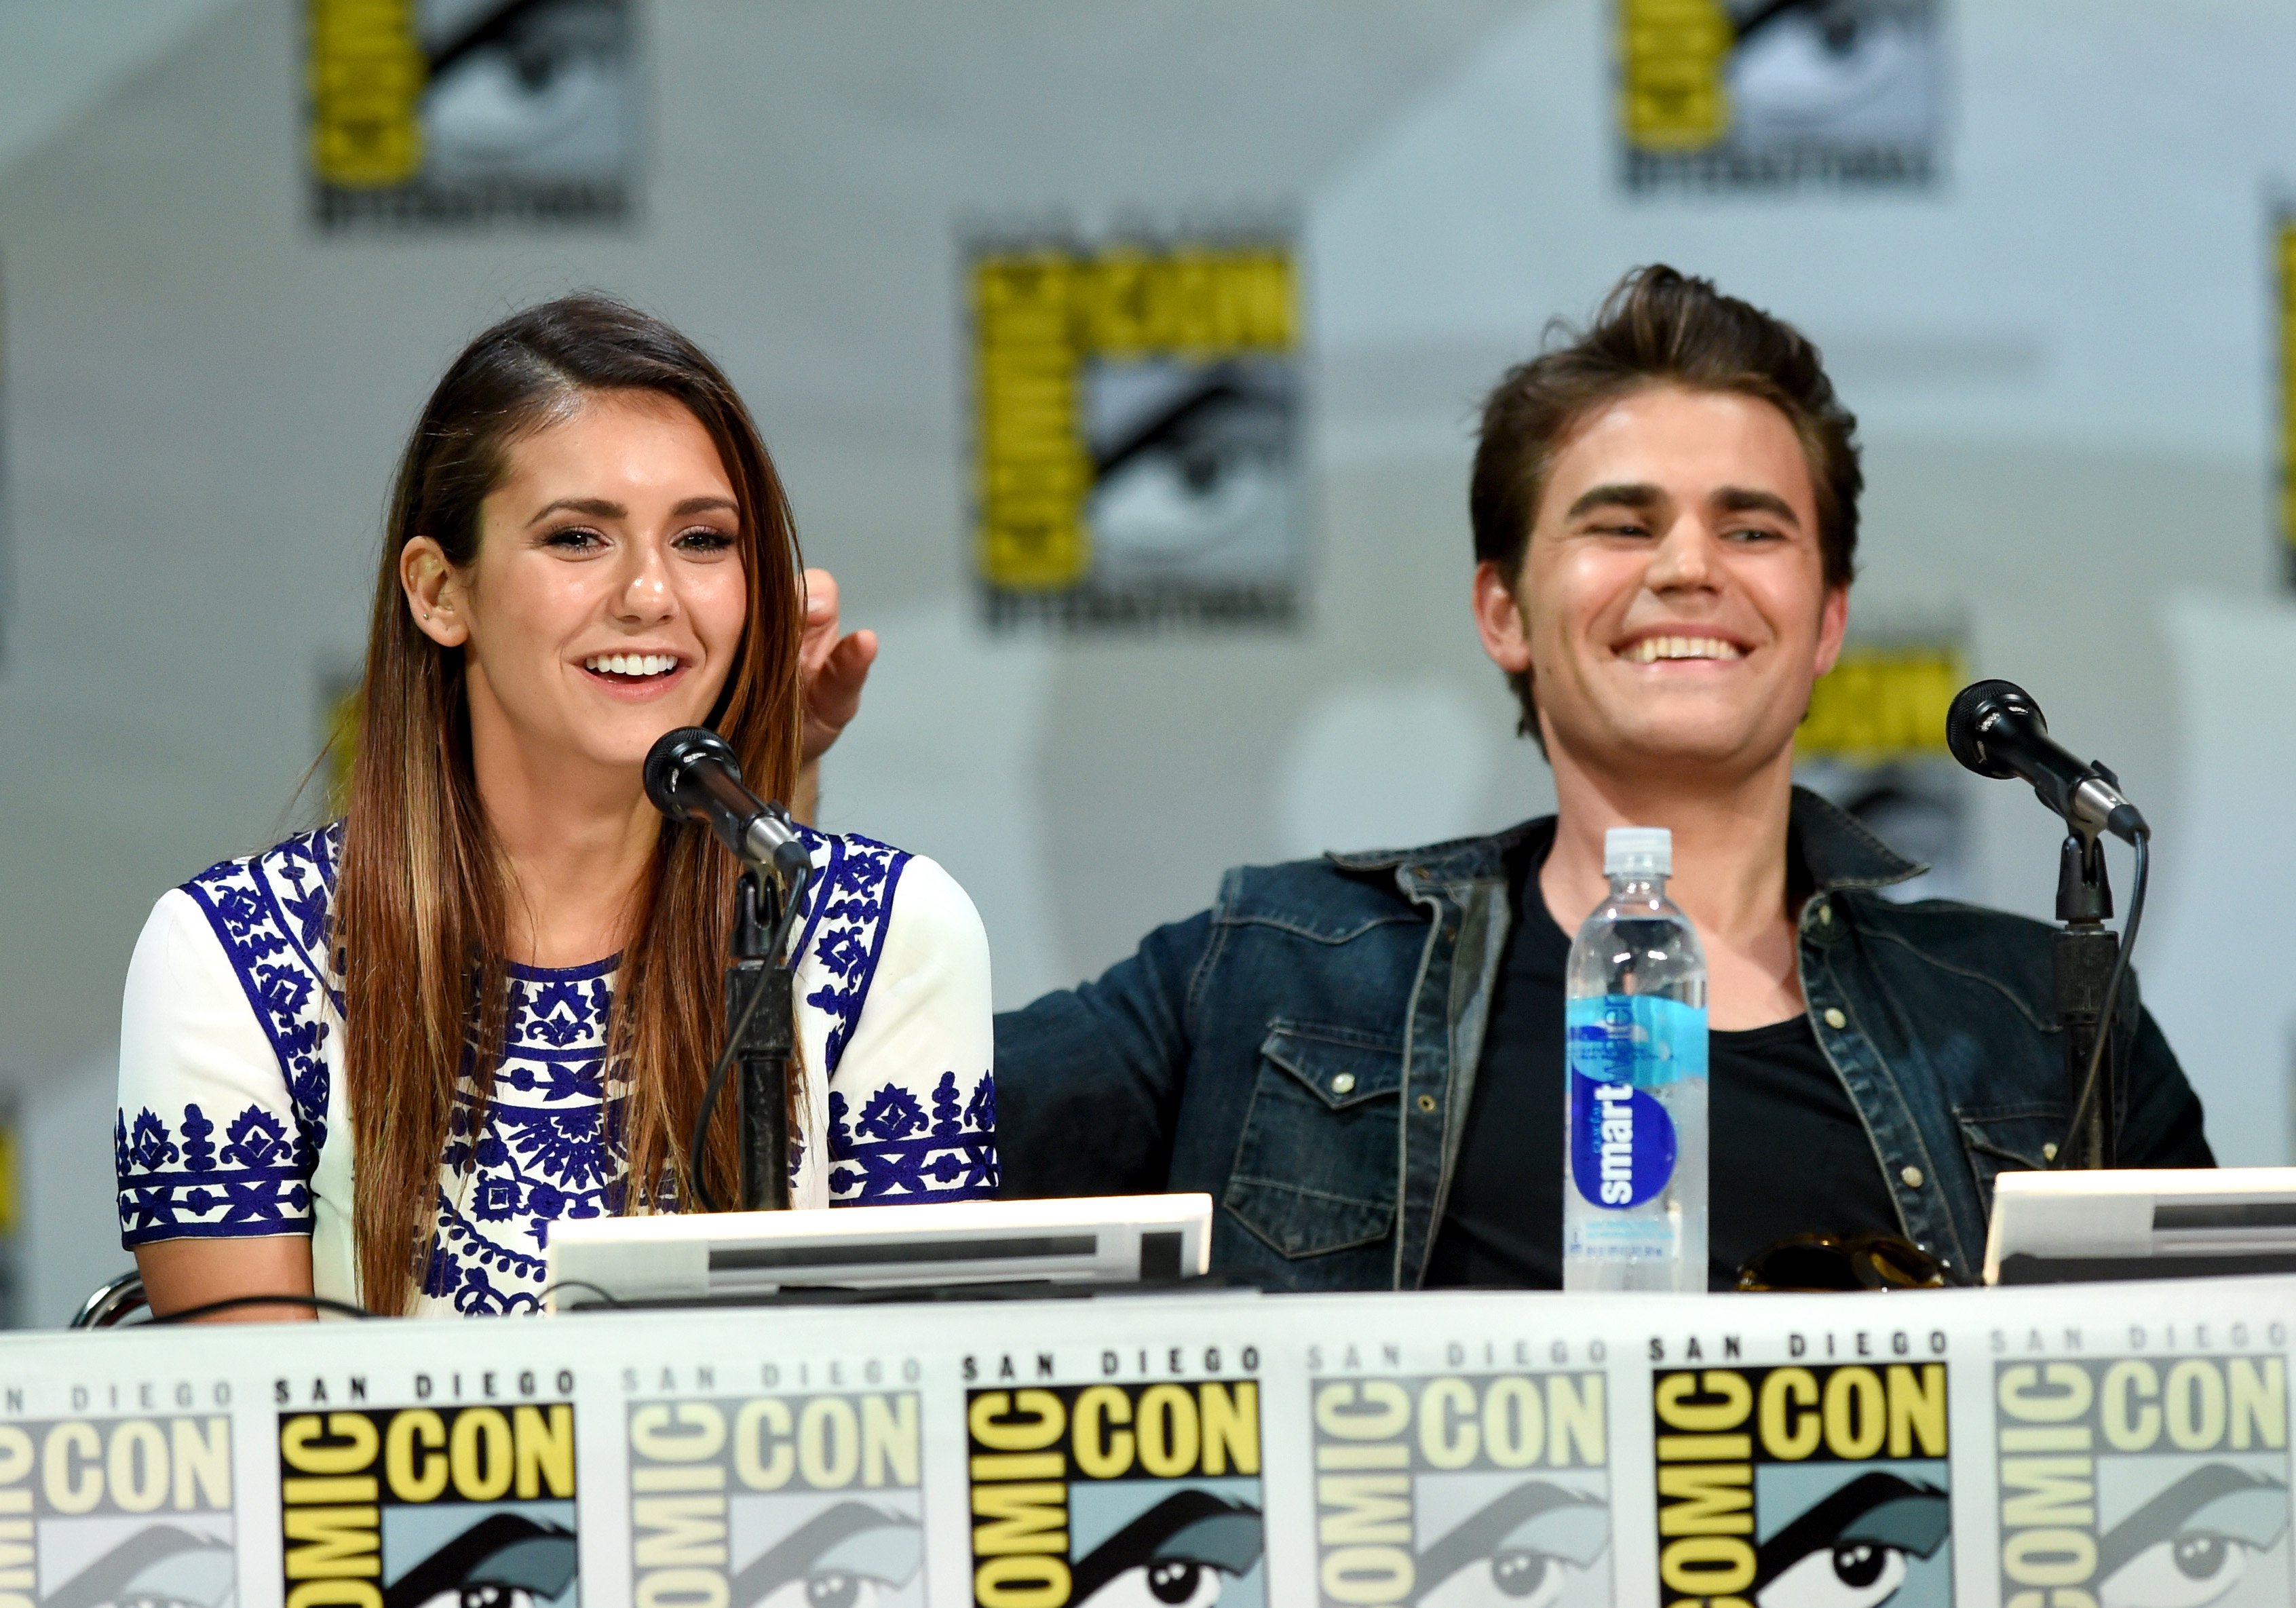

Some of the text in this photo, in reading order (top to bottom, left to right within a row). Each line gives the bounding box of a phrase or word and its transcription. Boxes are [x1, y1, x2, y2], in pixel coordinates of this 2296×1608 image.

[1594, 1083, 1633, 1205] smart
[274, 1368, 575, 1404] SAN DIEGO
[623, 1358, 921, 1393] SAN DIEGO
[962, 1347, 1259, 1381] SAN DIEGO
[1307, 1338, 1607, 1371] SAN DIEGO
[1649, 1331, 1947, 1361] SAN DIEGO
[1991, 1322, 2287, 1354] SAN DIEGO
[73, 1379, 232, 1409] DIEGO
[733, 1393, 919, 1491] CON
[1071, 1379, 1259, 1478] CON
[1417, 1373, 1606, 1470] CON
[1763, 1364, 1947, 1460] CON
[2101, 1357, 2286, 1452] CON
[42, 1415, 231, 1514] CON
[385, 1405, 575, 1501] CON
[968, 1387, 1073, 1608] OMIC
[1315, 1378, 1416, 1608] OMIC
[1653, 1369, 1758, 1608] OMIC
[631, 1400, 730, 1608] OMIC
